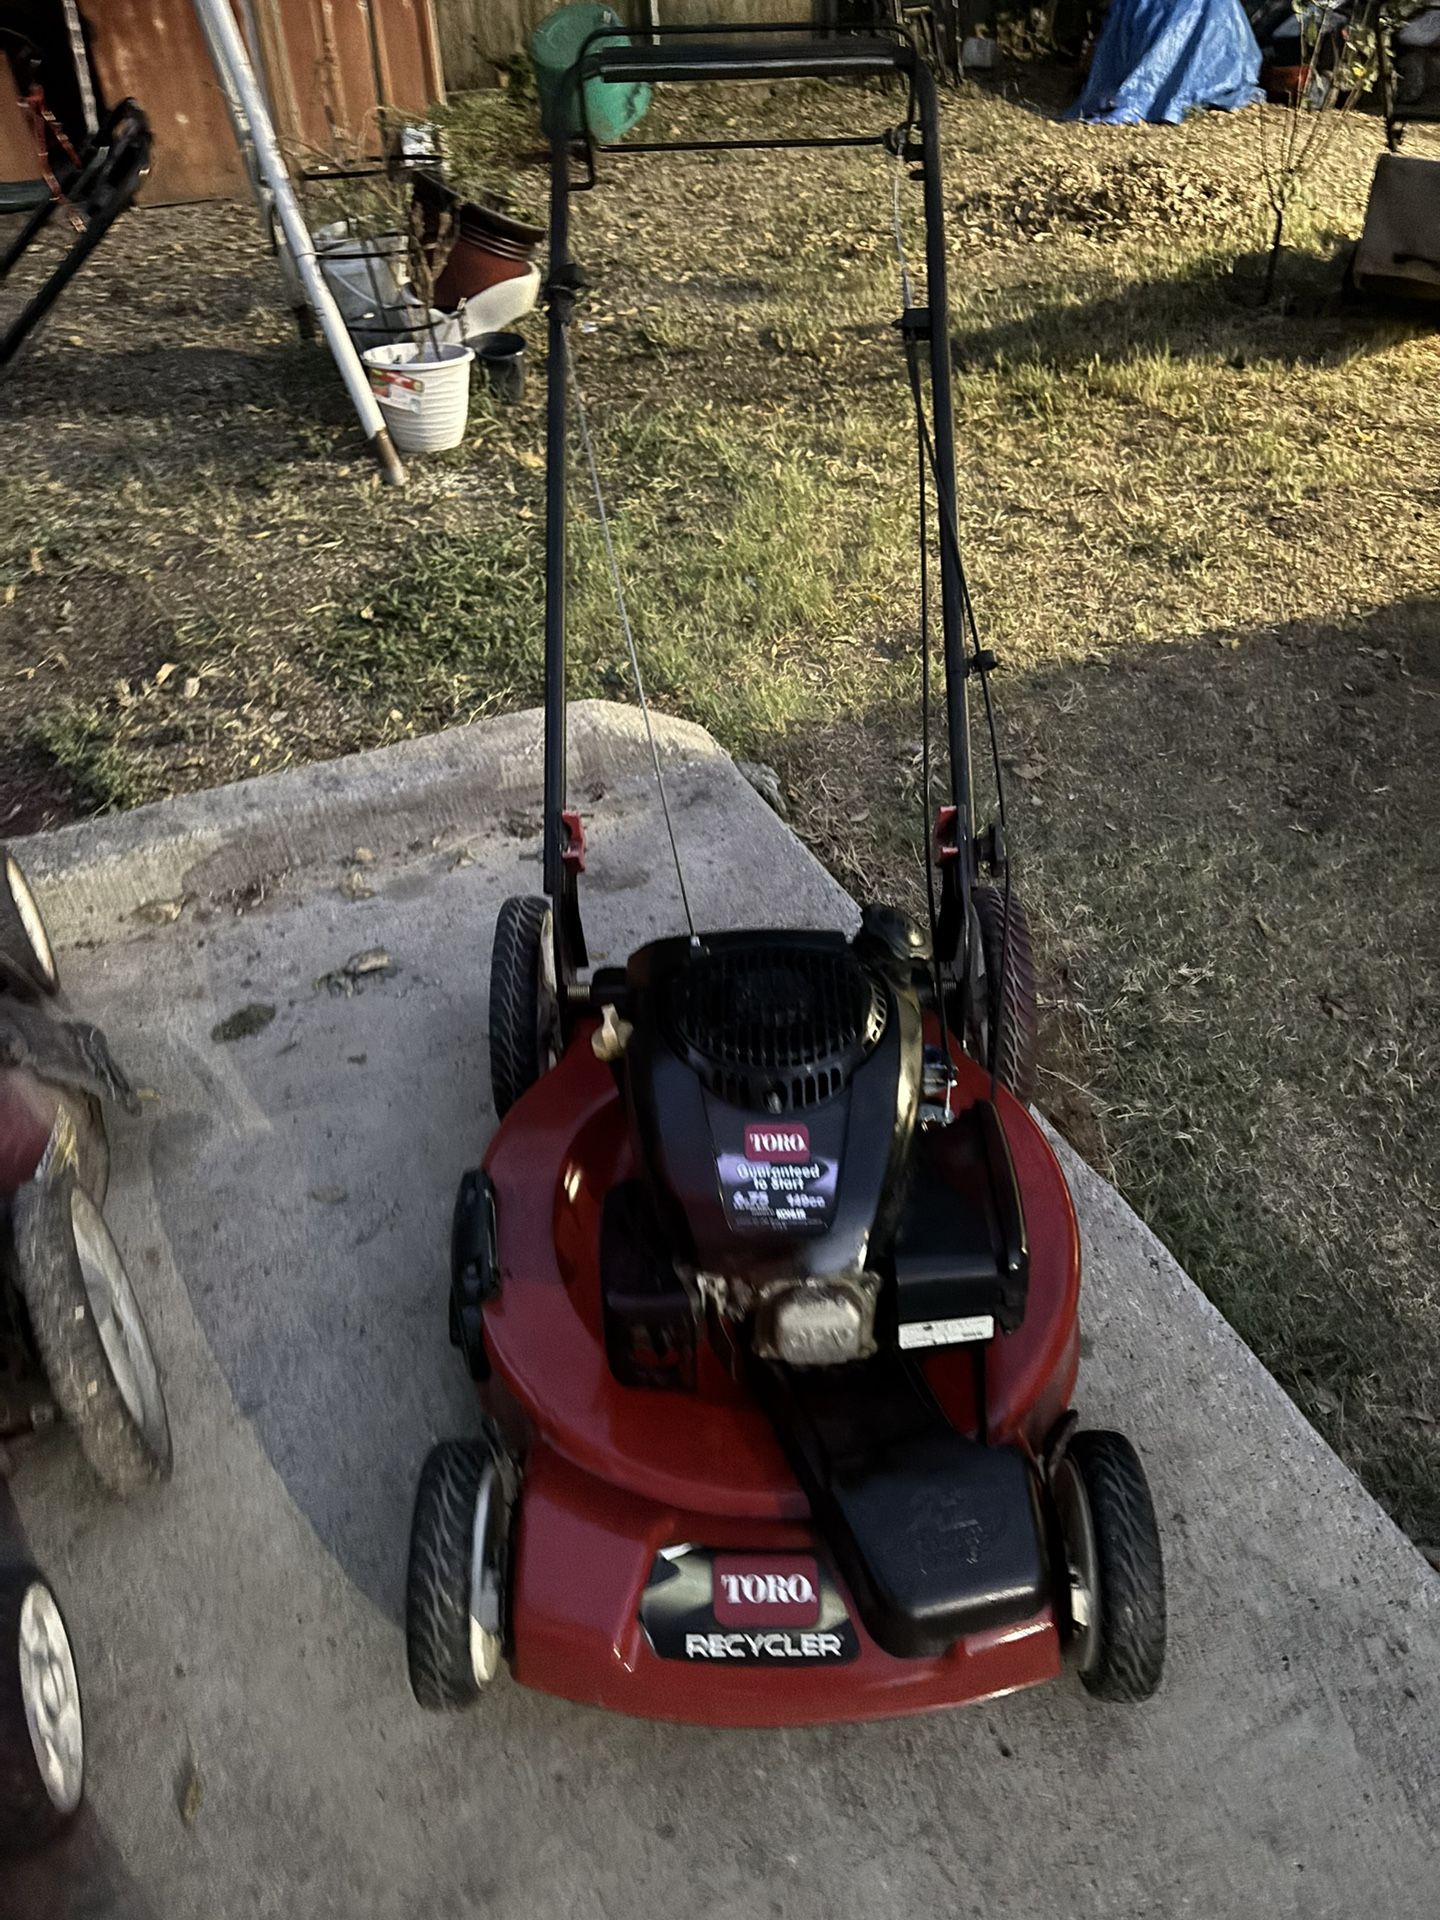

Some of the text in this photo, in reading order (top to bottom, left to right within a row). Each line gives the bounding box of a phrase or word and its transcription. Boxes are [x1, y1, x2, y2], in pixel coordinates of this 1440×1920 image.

[750, 1133, 806, 1152] TORO
[736, 1163, 820, 1179] Guaranteed
[770, 1177, 804, 1190] Start
[721, 1573, 813, 1603] TORO
[685, 1632, 842, 1658] RECYCLER
